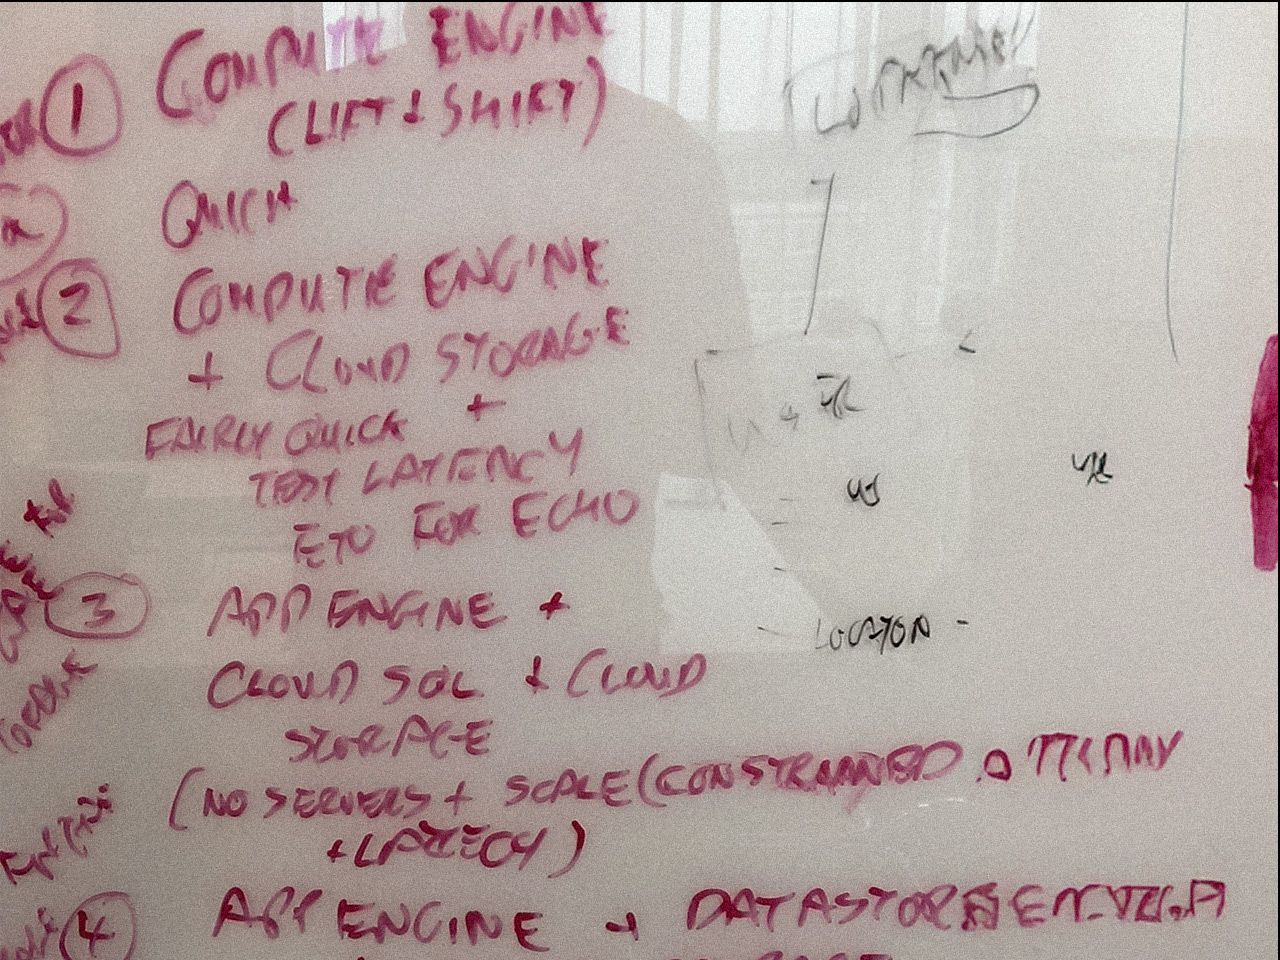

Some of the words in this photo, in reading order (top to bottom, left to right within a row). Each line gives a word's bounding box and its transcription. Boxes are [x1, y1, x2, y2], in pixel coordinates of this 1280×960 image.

[423, 235, 610, 310] ENGINE
[438, 305, 632, 384] STORAGE
[326, 586, 509, 632] ENGINE
[336, 896, 550, 953] ENGINE
